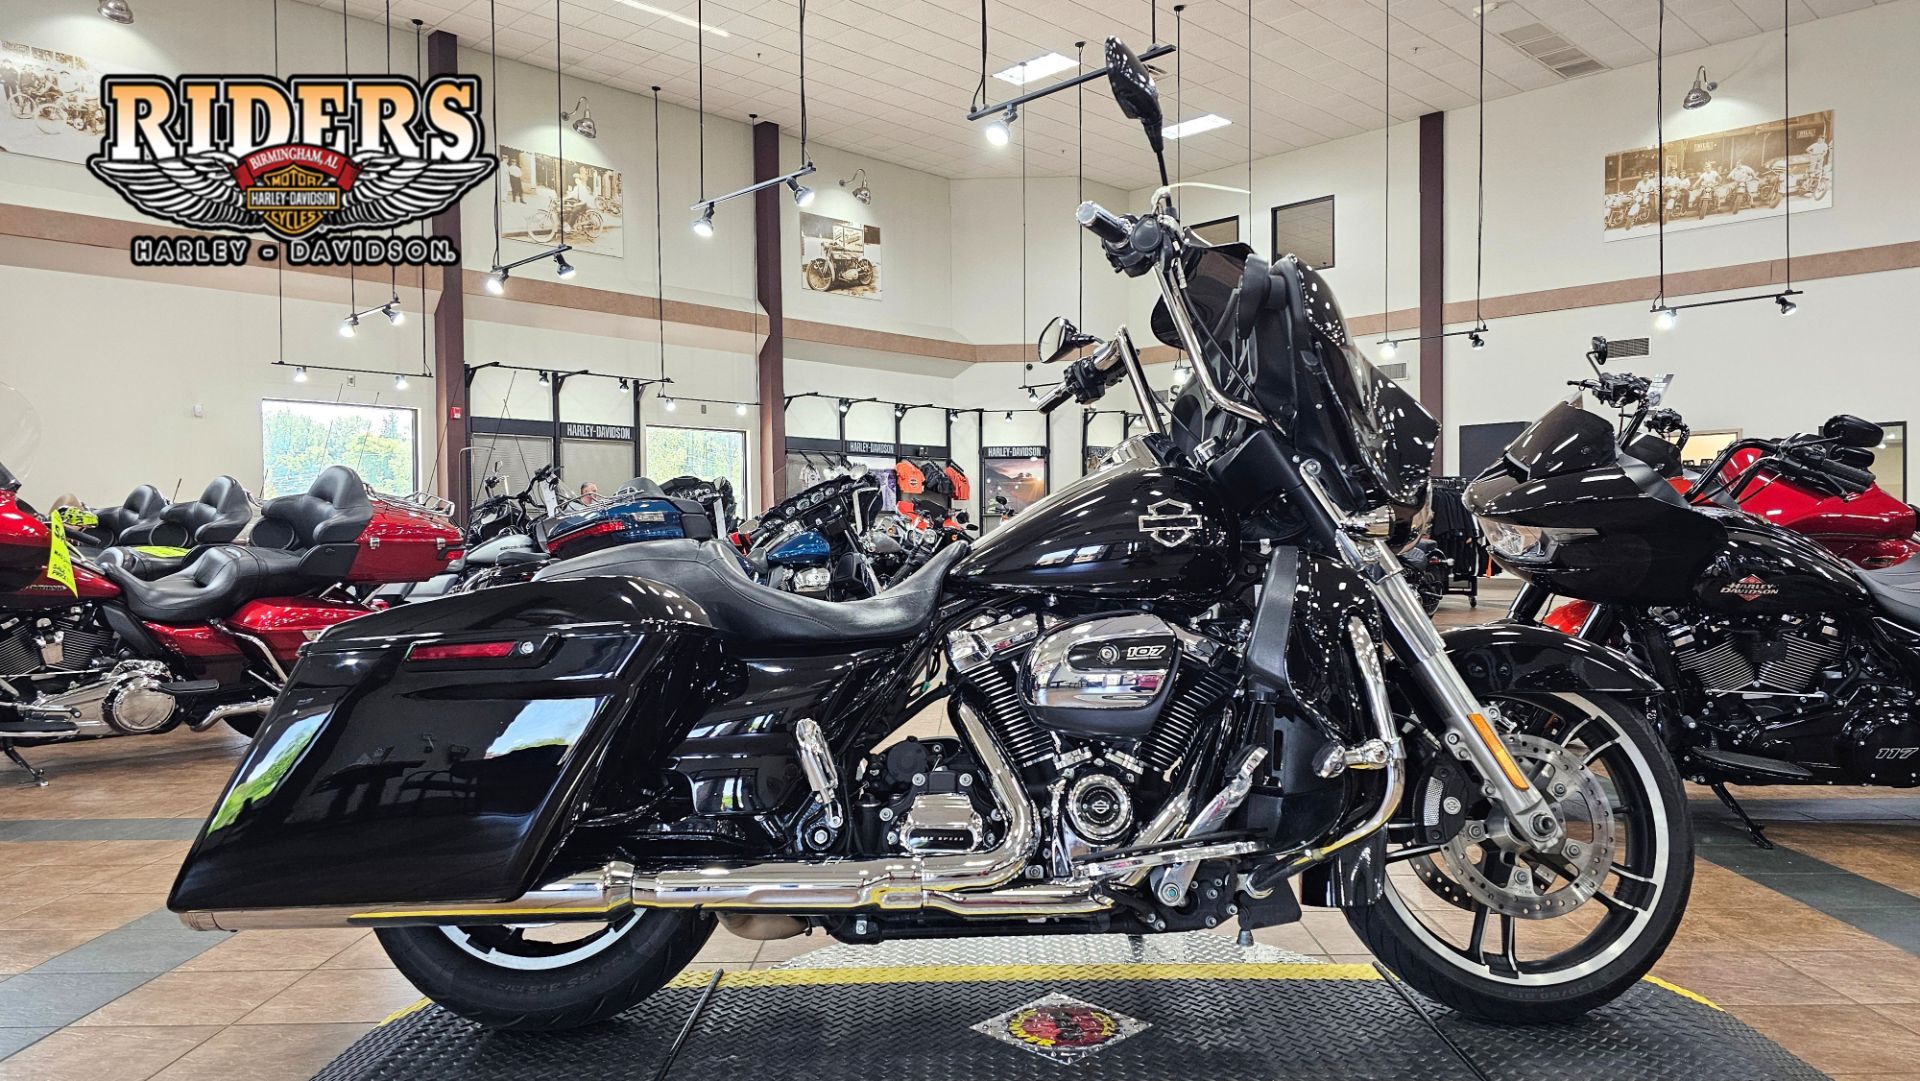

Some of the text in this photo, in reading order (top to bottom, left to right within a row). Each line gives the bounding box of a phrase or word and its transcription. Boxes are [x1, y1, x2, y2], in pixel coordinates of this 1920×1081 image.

[566, 424, 631, 440] HARLEY-DAVIDSON
[850, 441, 894, 454] HARLEY-DAVIDSON
[988, 447, 1042, 457] HARLEY-DAVIDSON
[1719, 587, 1779, 595] DAVIDSON
[1127, 645, 1167, 658] 107
[1875, 747, 1919, 759] 117
